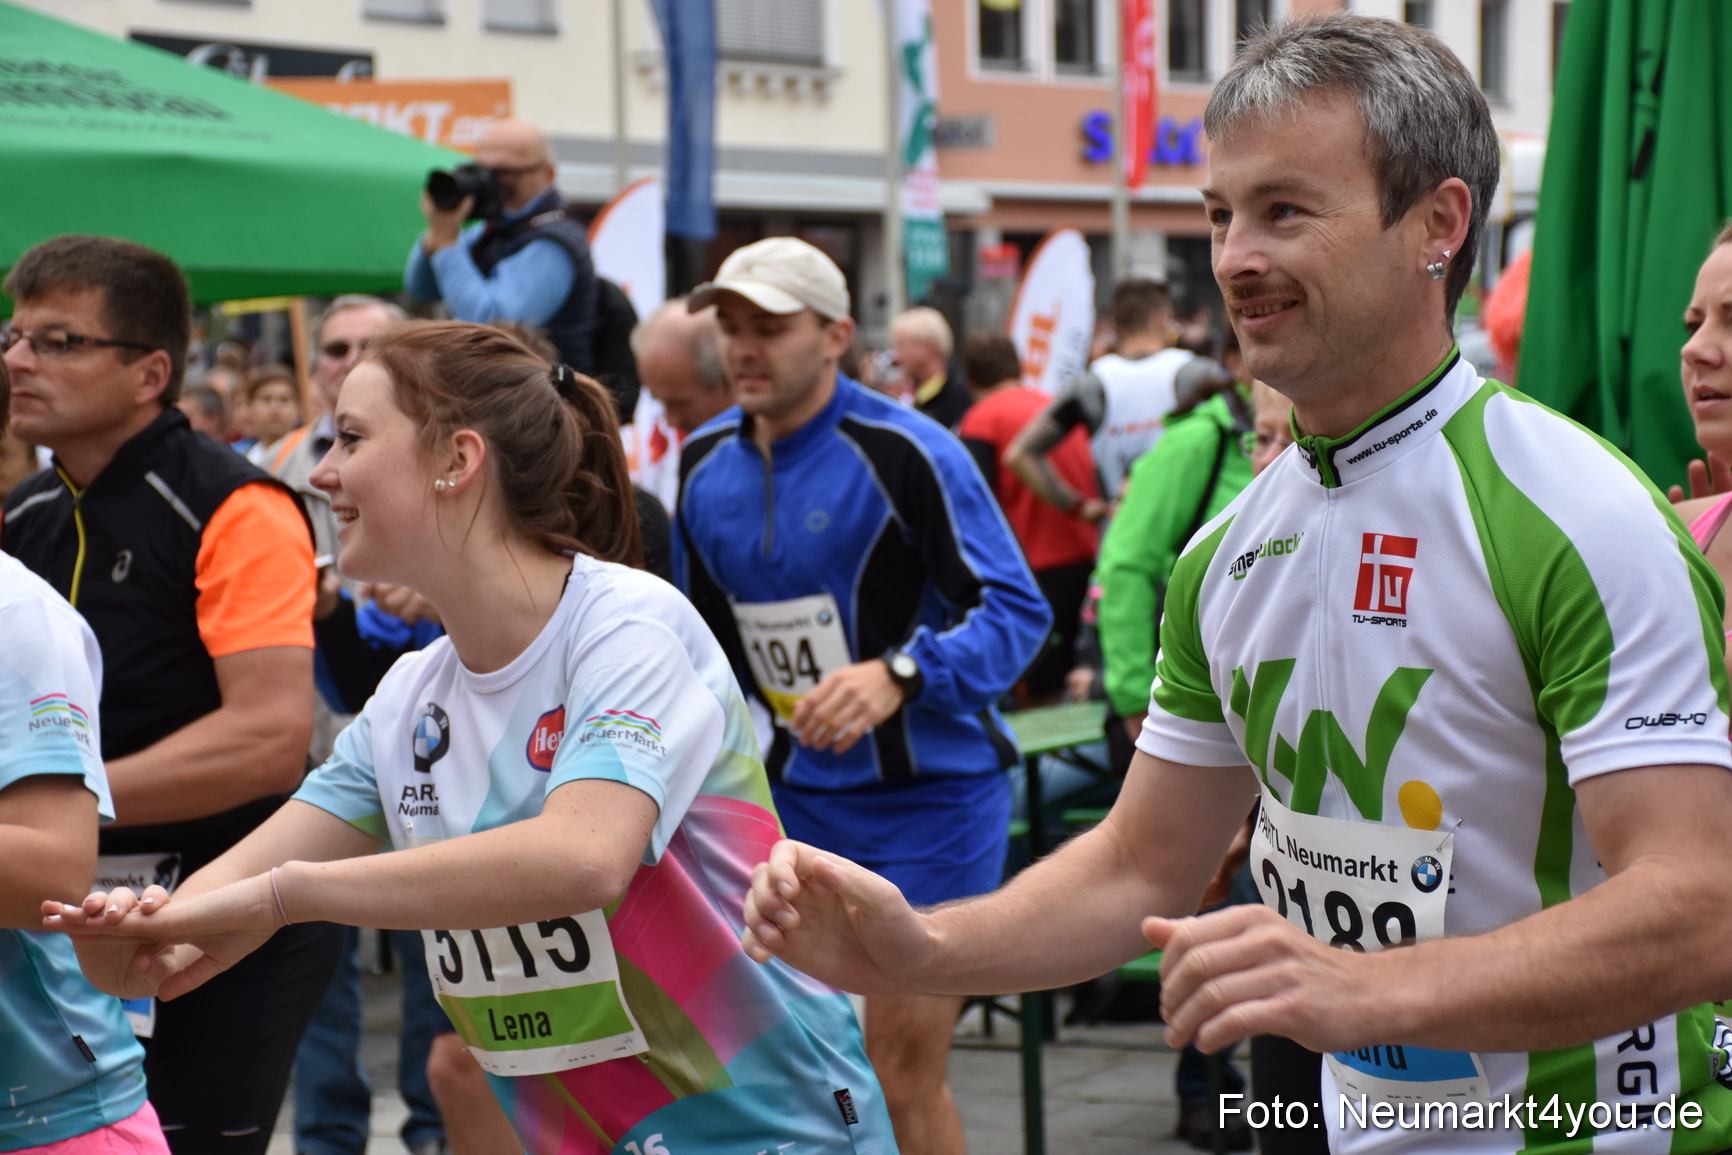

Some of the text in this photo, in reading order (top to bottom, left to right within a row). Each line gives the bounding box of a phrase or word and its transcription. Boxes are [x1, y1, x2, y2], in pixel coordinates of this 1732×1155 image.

[1346, 408, 1438, 465] www.tu-sports.de
[1352, 614, 1407, 628] TU-SPORTS
[752, 637, 822, 687] 194
[1625, 713, 1707, 730] owayo
[1258, 806, 1398, 883] PARTL Neumarkt
[434, 916, 590, 984] 5115
[488, 1008, 552, 1041] Lena
[1343, 1045, 1408, 1070] ard
